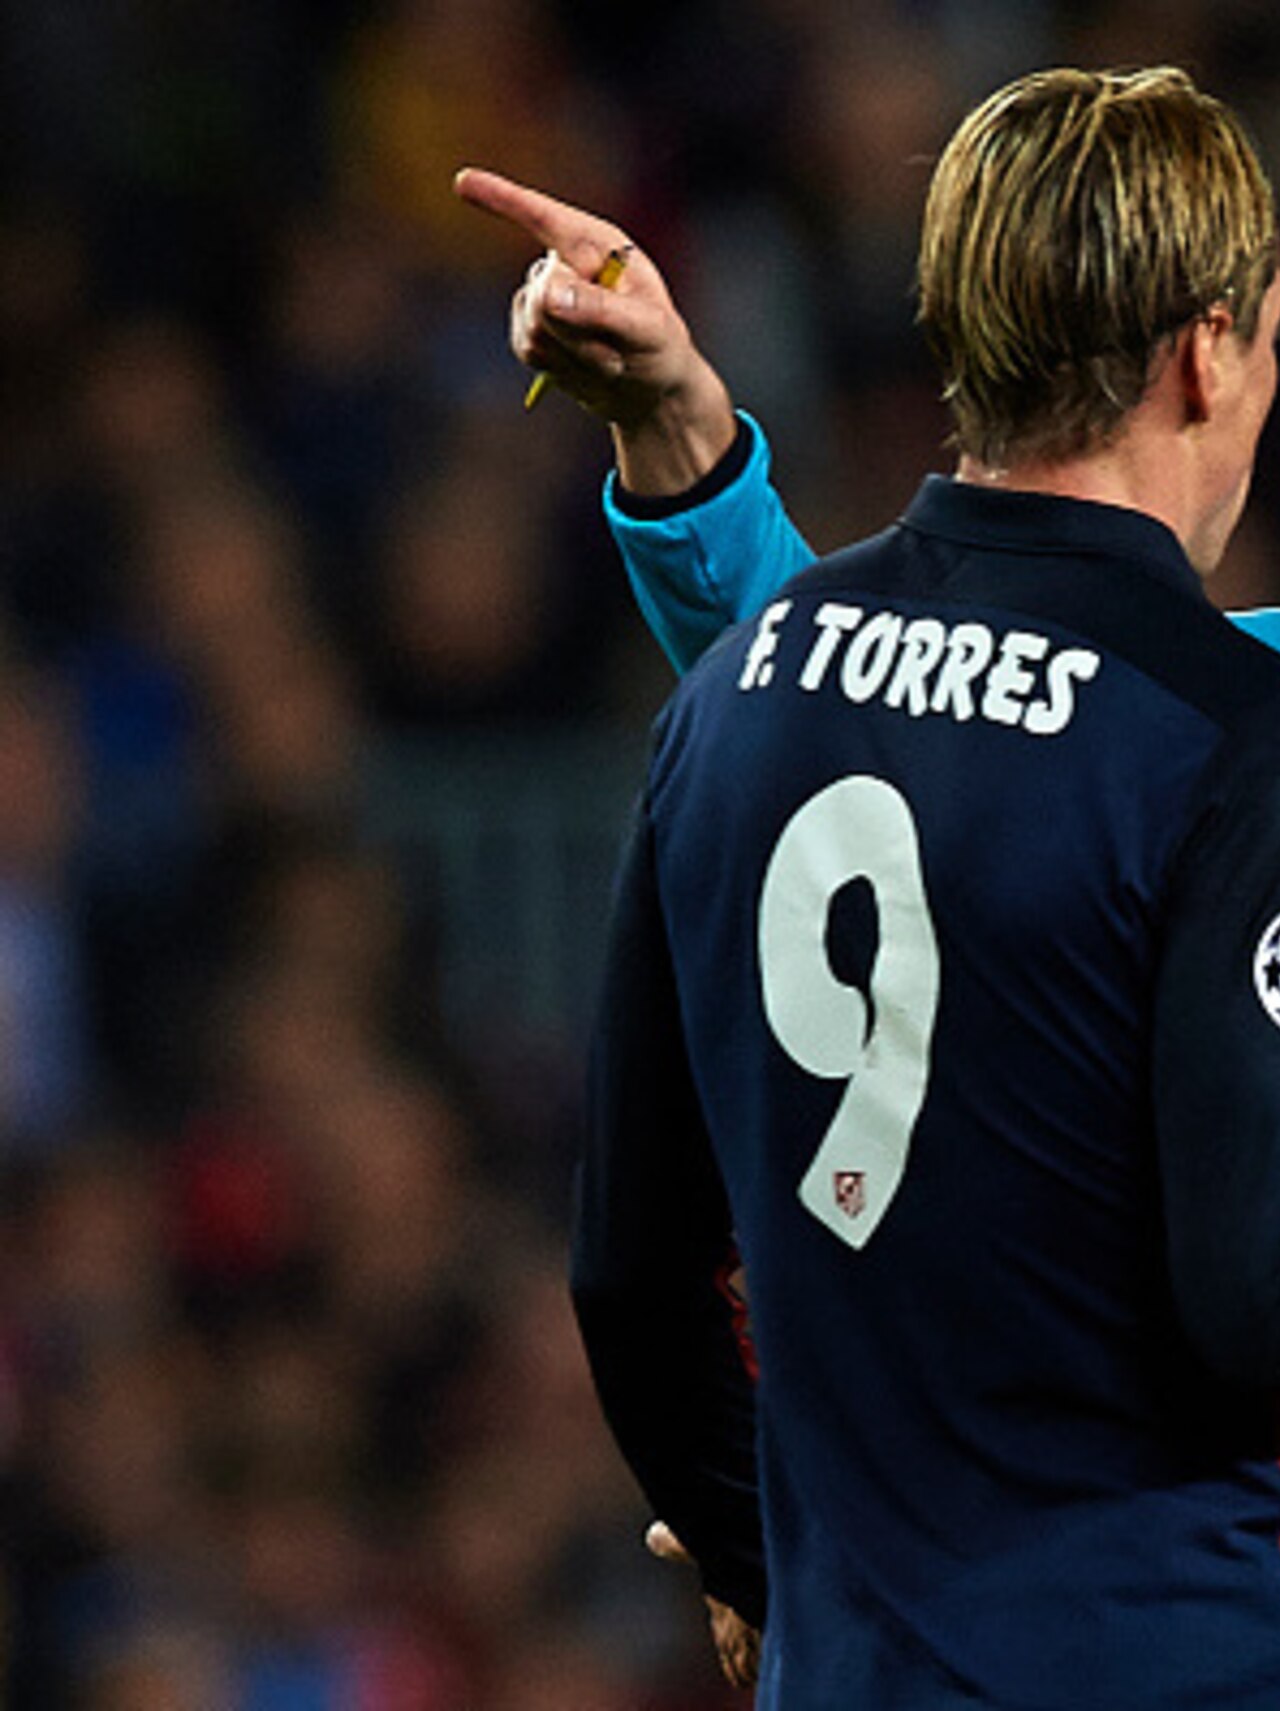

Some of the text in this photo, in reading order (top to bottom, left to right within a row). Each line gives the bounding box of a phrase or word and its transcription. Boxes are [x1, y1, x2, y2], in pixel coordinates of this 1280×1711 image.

[738, 600, 1100, 734] F. TORRES
[758, 774, 940, 1251] 9
